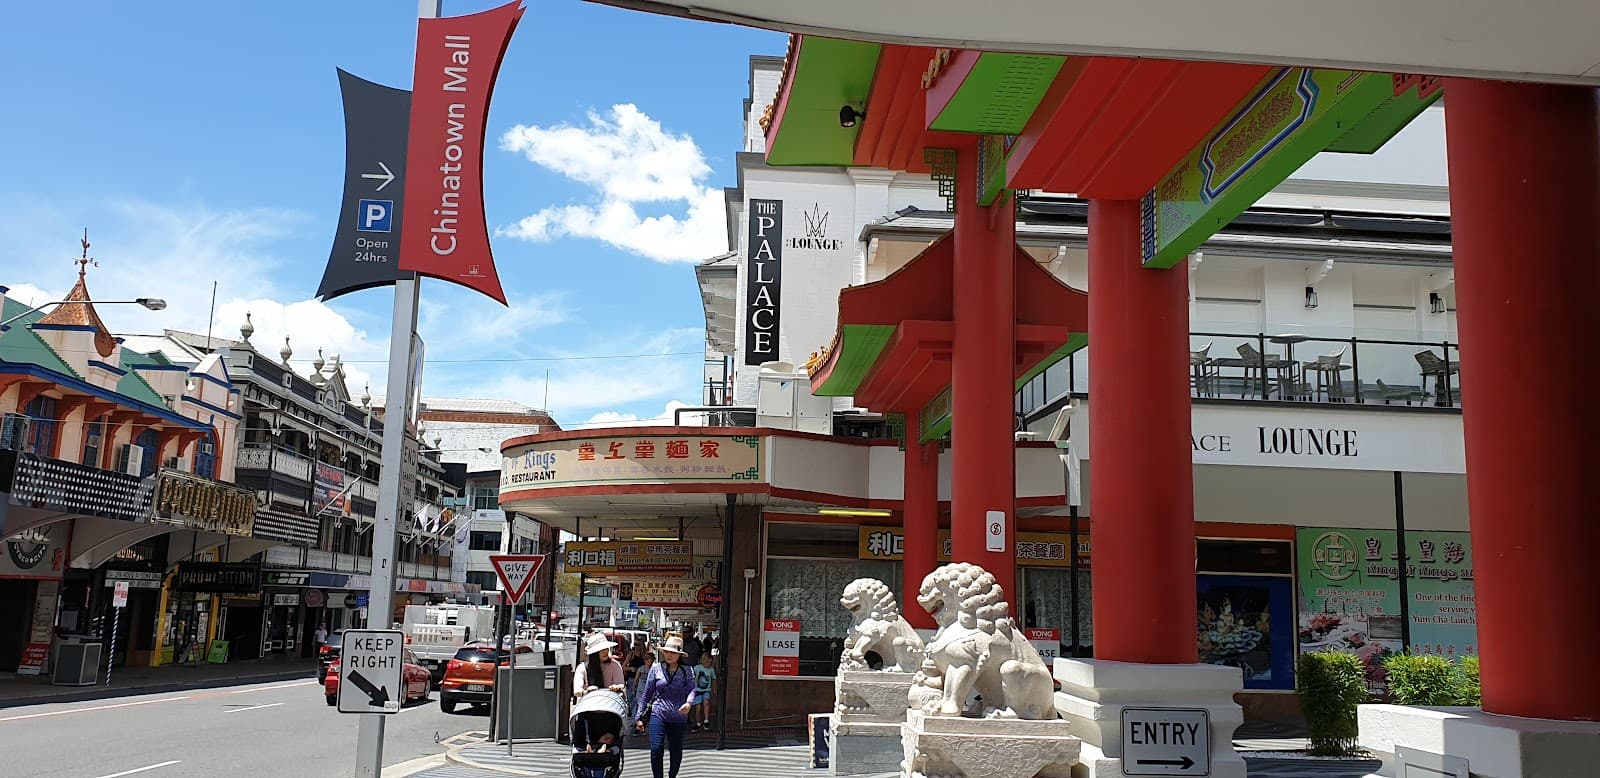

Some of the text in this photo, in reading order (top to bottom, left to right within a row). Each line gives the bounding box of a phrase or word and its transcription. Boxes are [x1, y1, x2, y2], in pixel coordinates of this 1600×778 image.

[431, 34, 471, 255] Chinatown Mall
[366, 204, 386, 228] P
[356, 238, 388, 250] Open
[355, 251, 387, 263] 24hrs
[752, 202, 776, 353] THE PALACE
[1257, 426, 1358, 457] LOUNGE
[403, 446, 415, 466] END
[524, 448, 556, 470] Kings
[511, 470, 556, 484] RESTAURANT
[567, 549, 616, 566] 利口福
[504, 563, 528, 573] GIVE
[1419, 564, 1457, 581] Kings
[1415, 593, 1432, 601] One
[1445, 593, 1458, 602] the
[1439, 606, 1469, 615] serving
[771, 621, 793, 629] YONG
[1413, 615, 1431, 624] Yum
[1432, 615, 1448, 624] Cha
[1031, 630, 1053, 638] YONG
[354, 637, 394, 651] KEEP
[767, 640, 796, 649] LEASE
[350, 655, 396, 669] RIGHT
[1130, 721, 1199, 745] ENTRY
